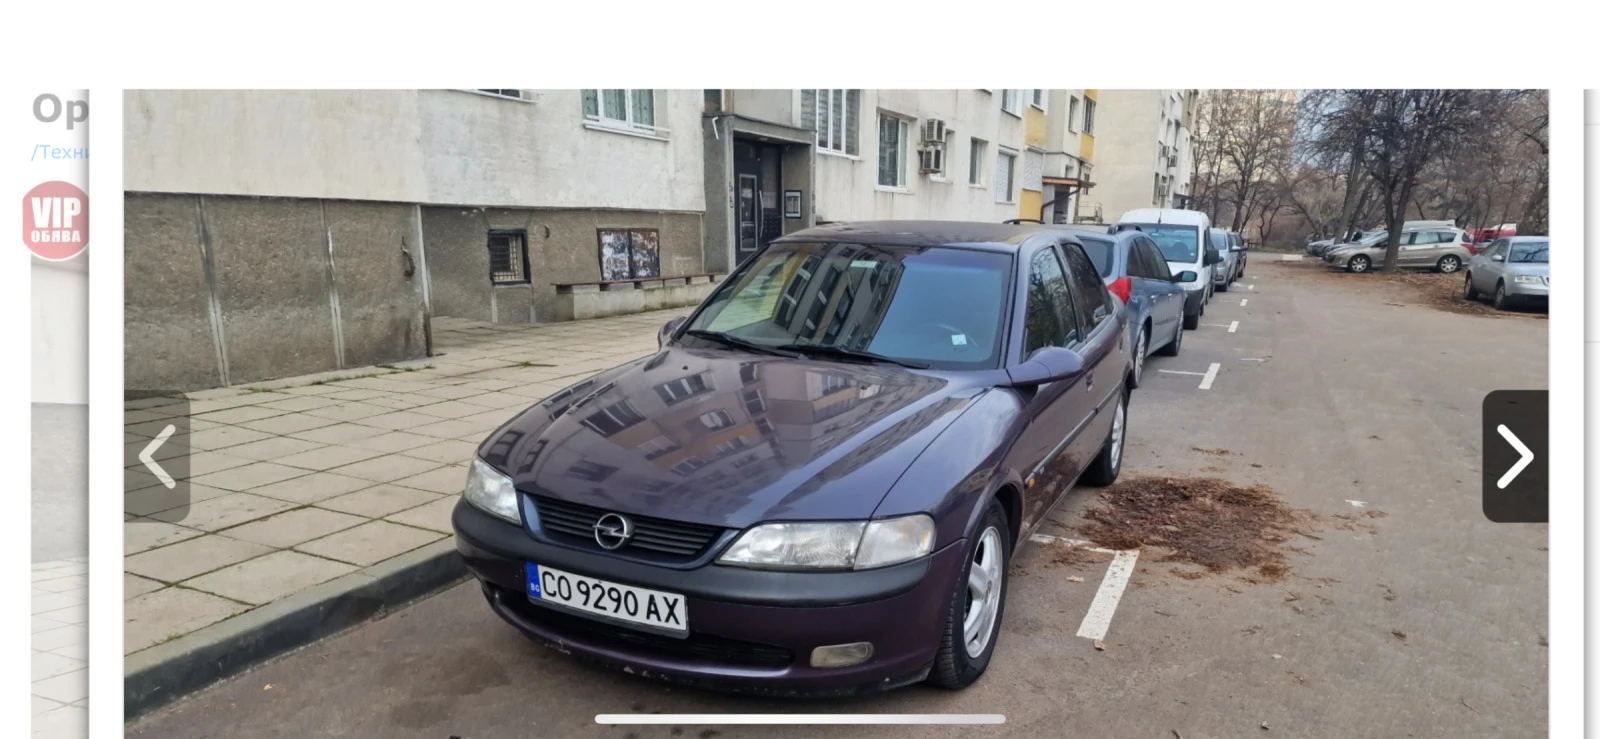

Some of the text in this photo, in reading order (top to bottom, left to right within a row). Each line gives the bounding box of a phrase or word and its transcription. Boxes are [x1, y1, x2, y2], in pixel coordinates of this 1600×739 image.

[530, 582, 540, 592] BG
[541, 571, 681, 625] CO 9290 AX
